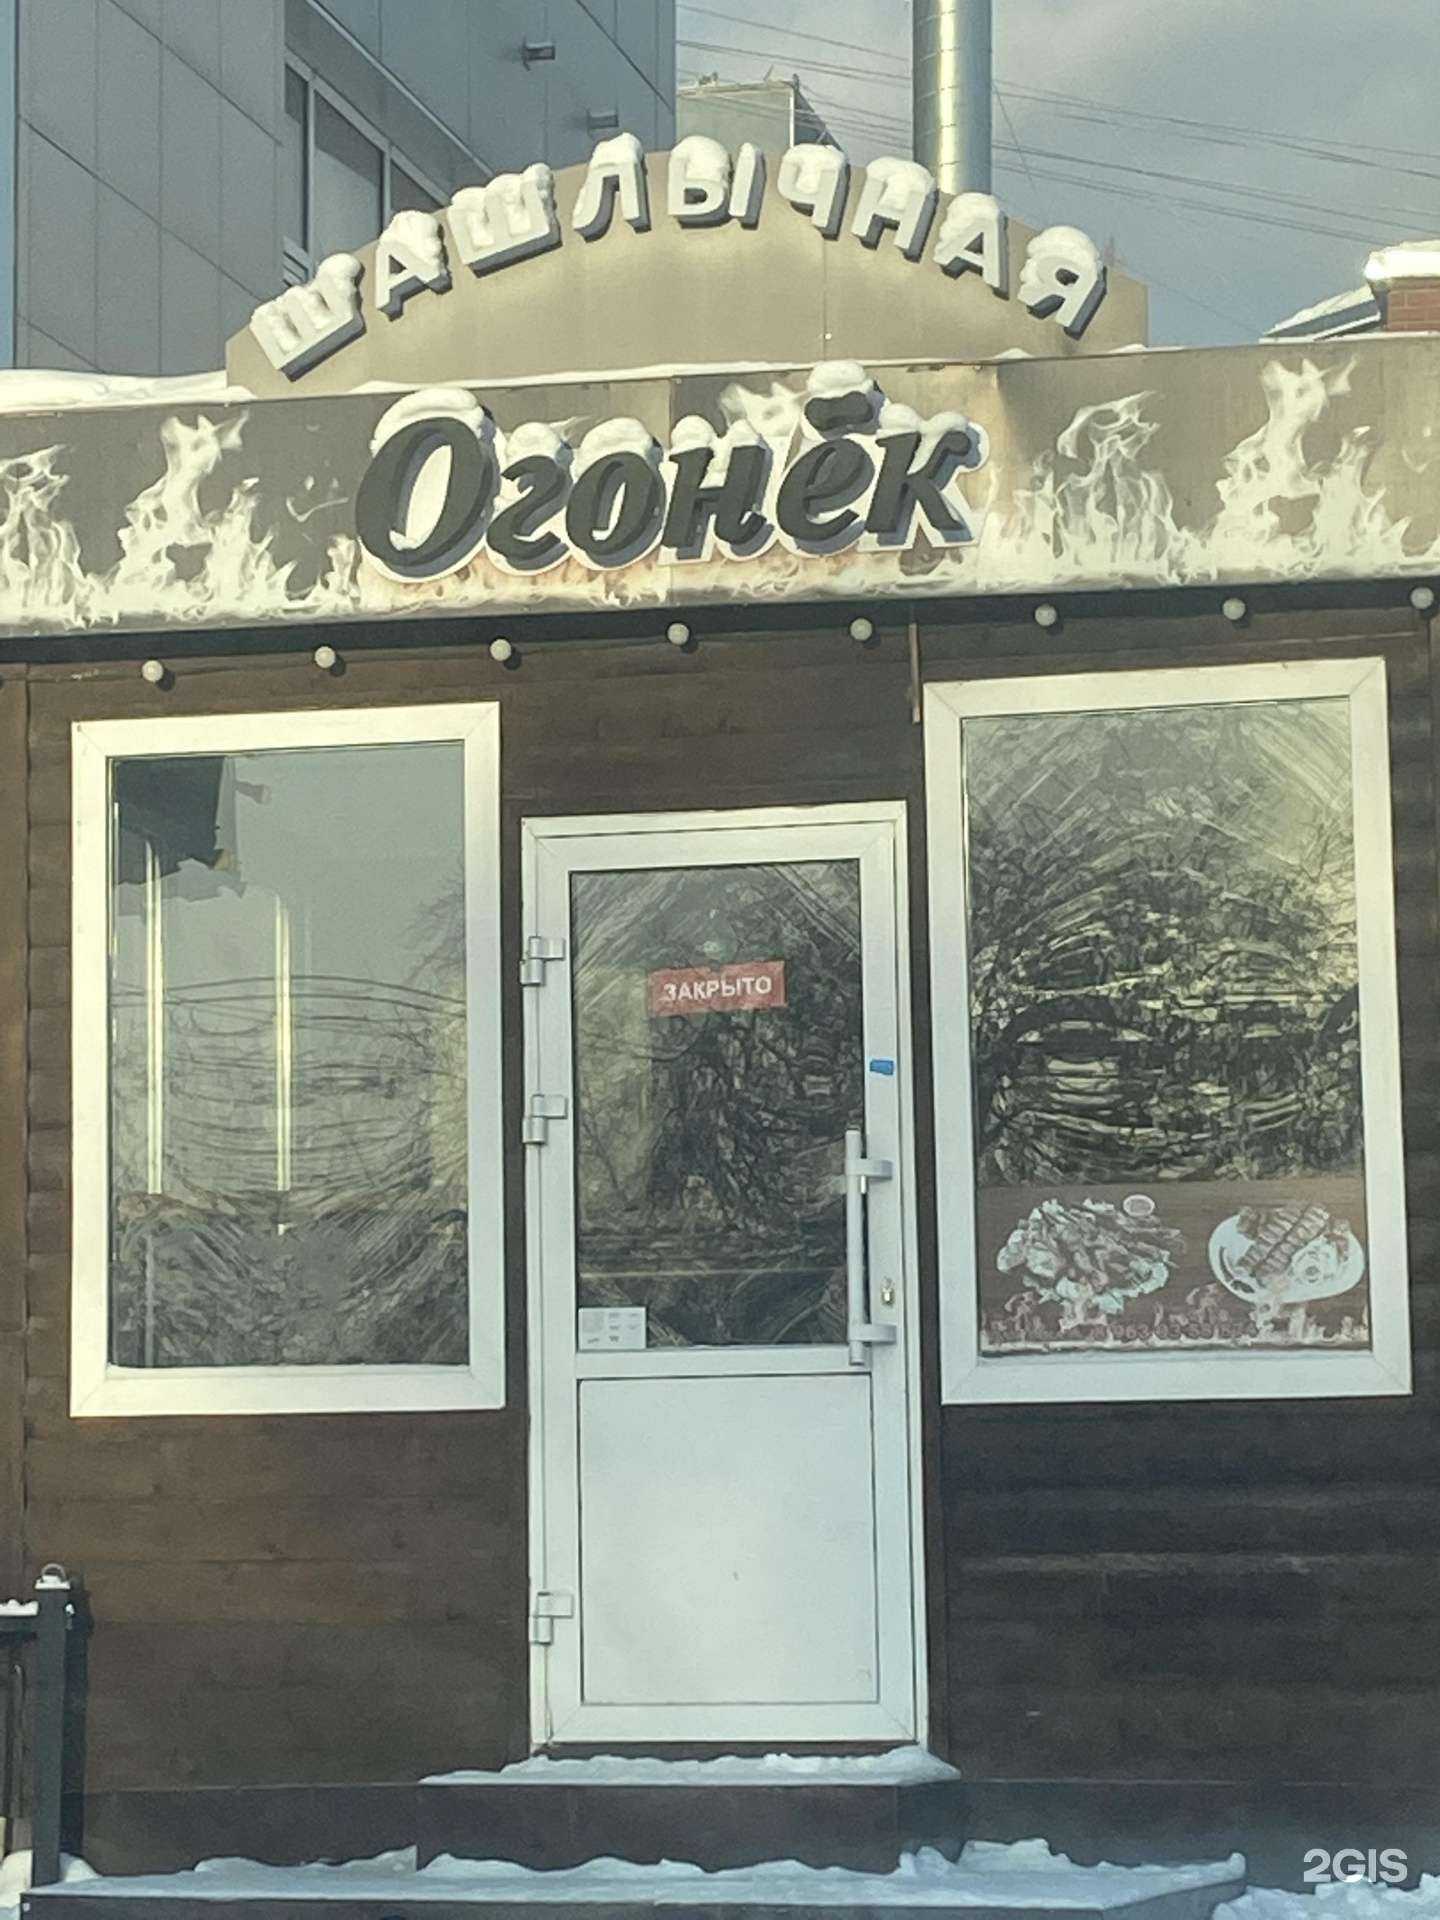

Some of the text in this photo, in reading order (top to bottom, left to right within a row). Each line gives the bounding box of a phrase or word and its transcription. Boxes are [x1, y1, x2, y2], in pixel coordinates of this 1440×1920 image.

[249, 132, 1107, 380] ШАШЛЫЧНАЯ
[354, 385, 976, 579] Огонёк
[663, 975, 773, 1001] ЗАКРЫТО
